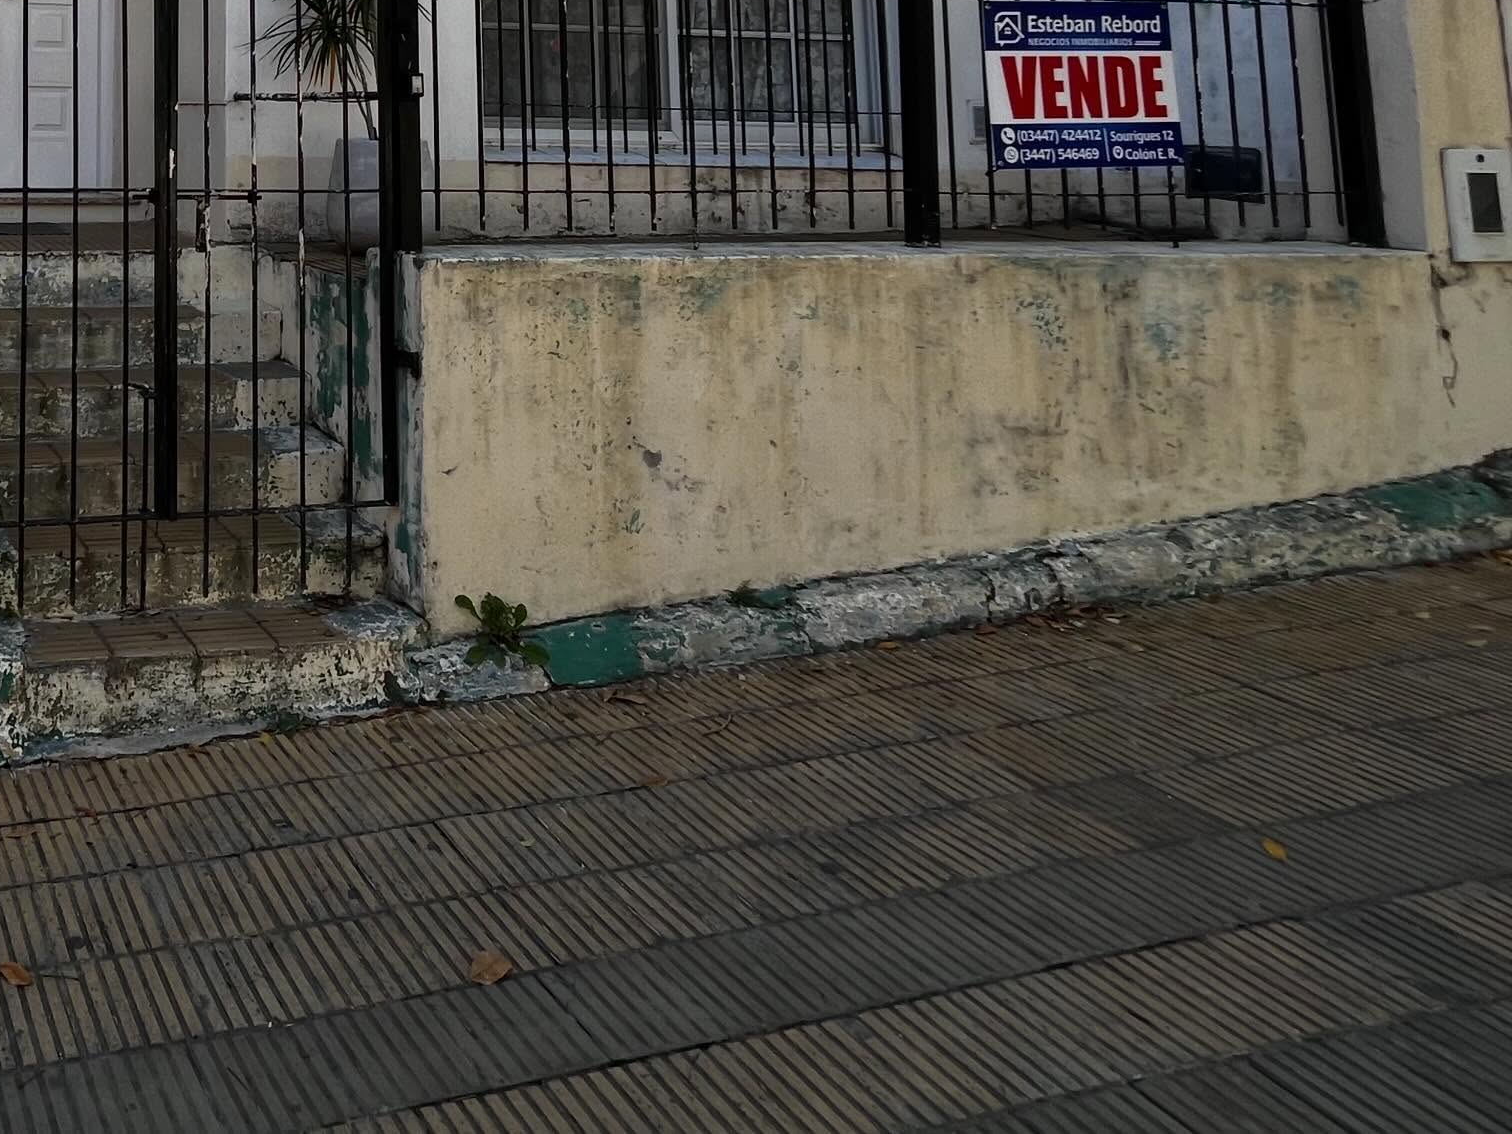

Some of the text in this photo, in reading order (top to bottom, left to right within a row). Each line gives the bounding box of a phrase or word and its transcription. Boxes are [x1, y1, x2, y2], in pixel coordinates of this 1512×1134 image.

[1028, 14, 1161, 33] Esteban Rebord
[1028, 38, 1133, 46] NEGOCIOS INMOBILIARIOS
[1000, 56, 1168, 119] VENDE
[1017, 130, 1102, 145] (03447) 424412
[1110, 130, 1174, 144] Sourigues 12
[1020, 148, 1100, 164] (3447) 546469
[1125, 148, 1156, 160] Colón
